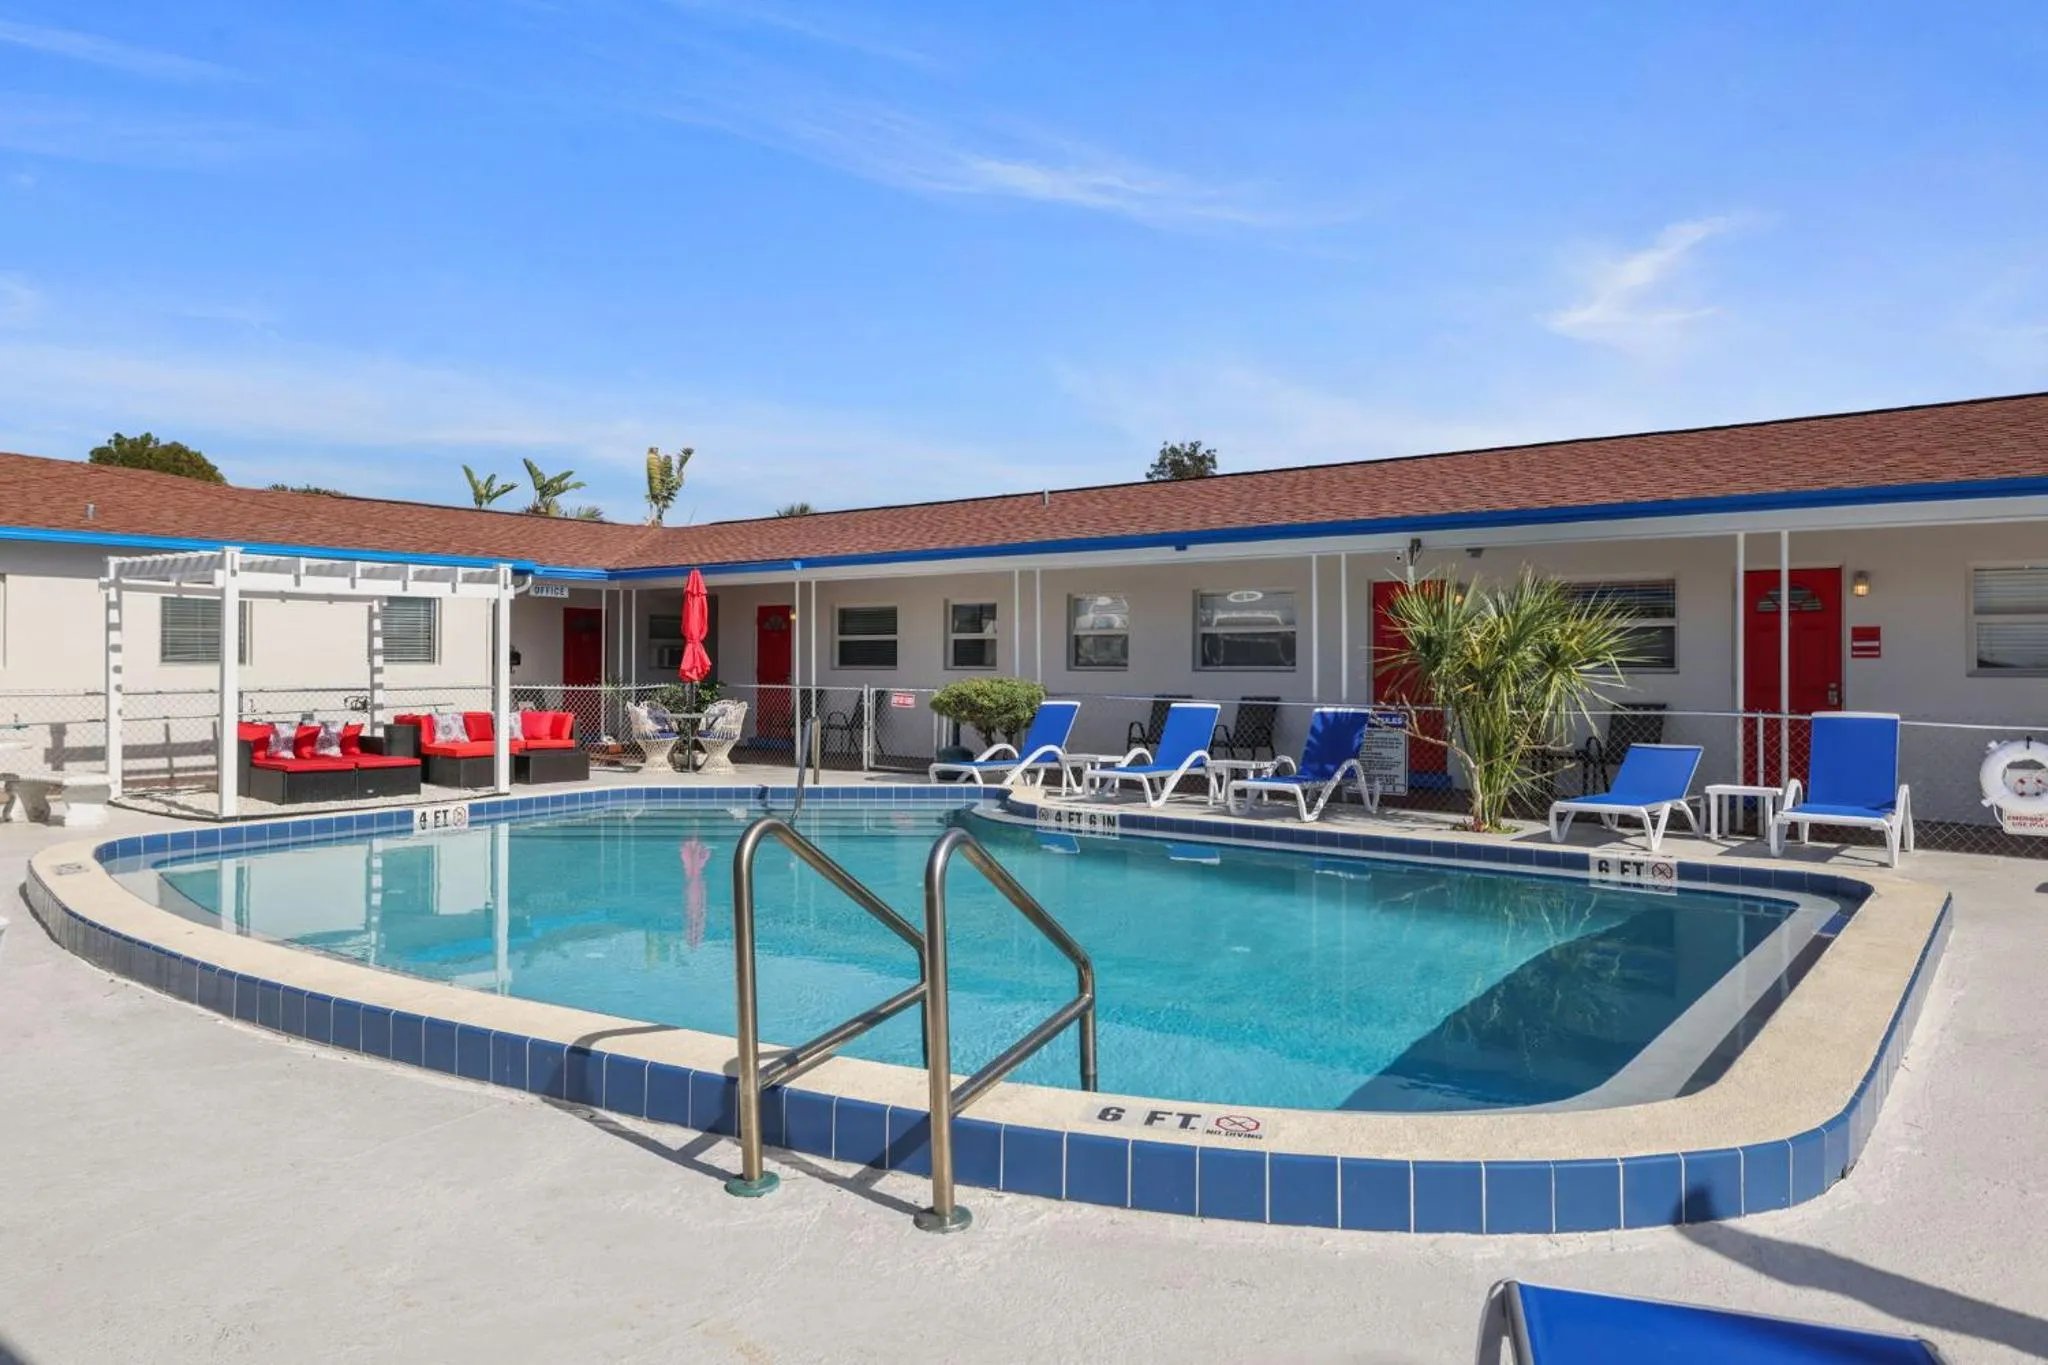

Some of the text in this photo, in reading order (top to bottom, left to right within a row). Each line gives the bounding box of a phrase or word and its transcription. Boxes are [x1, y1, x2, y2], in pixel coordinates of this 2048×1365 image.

[534, 586, 565, 596] OFFICE
[419, 811, 427, 826] 4
[1055, 811, 1062, 822] 4
[1068, 812, 1082, 824] FT
[1102, 815, 1116, 828] IN
[1598, 860, 1645, 876] 6 FT
[1097, 1106, 1126, 1122] 6
[1225, 1131, 1263, 1140] DIVING
